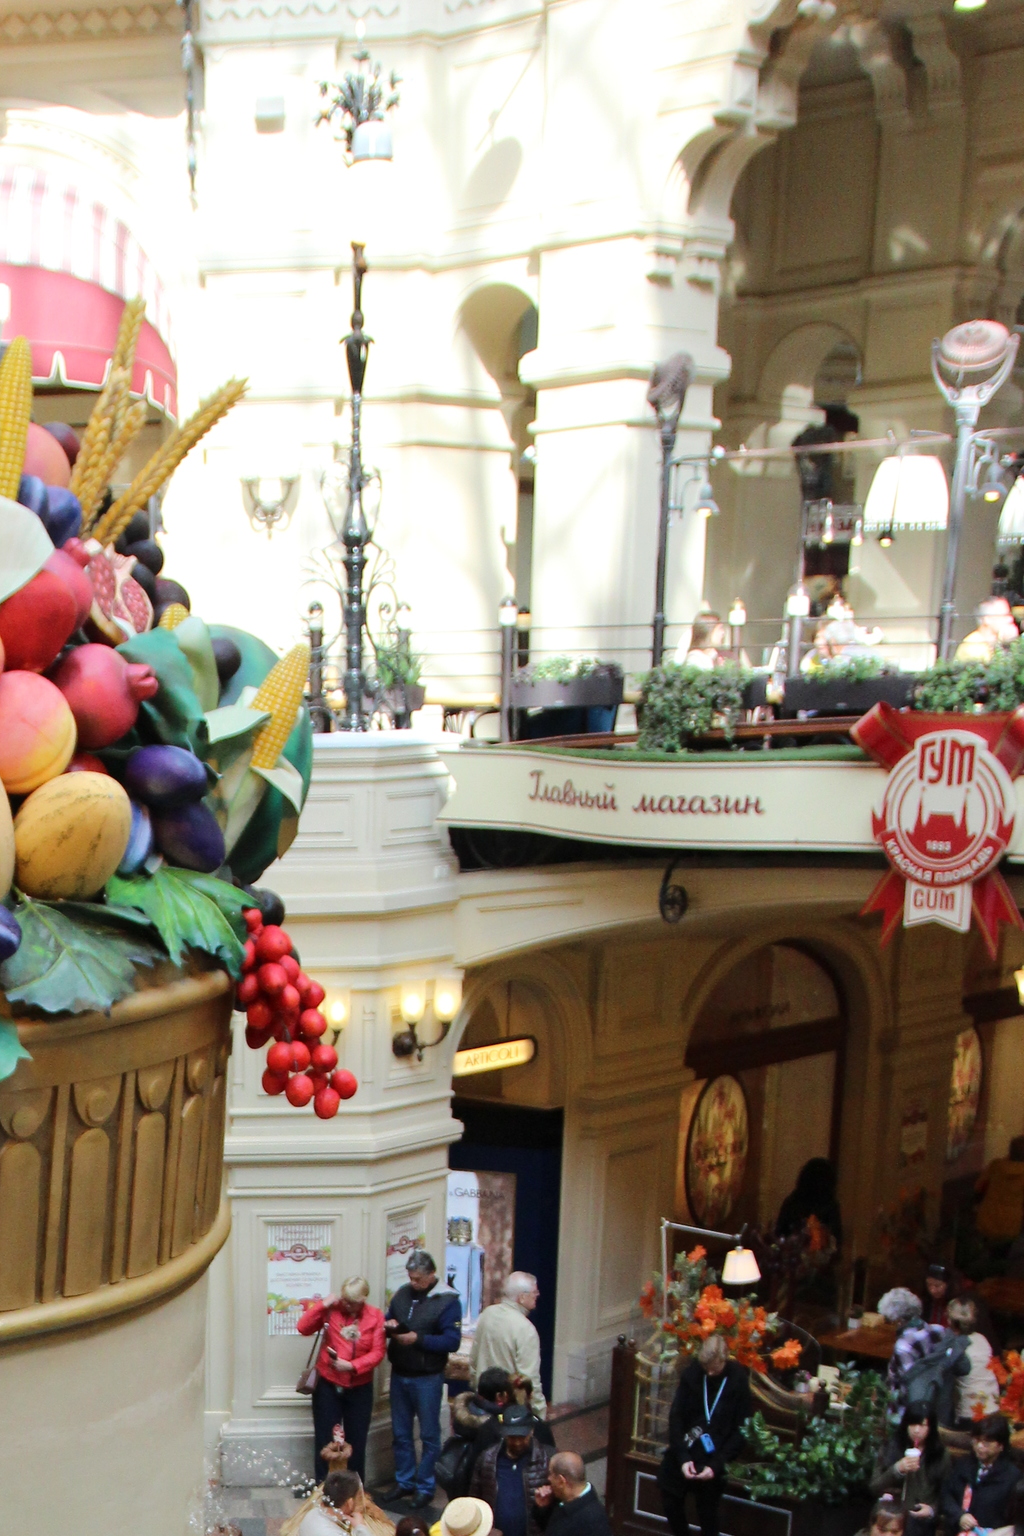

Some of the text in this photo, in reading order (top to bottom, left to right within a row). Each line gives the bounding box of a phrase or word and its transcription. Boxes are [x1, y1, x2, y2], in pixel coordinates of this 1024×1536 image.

[918, 736, 976, 786] ГУМ
[529, 768, 764, 815] Главный магазин
[885, 838, 994, 883] КРАСНАЯ ПЛОЩАДЬ
[913, 888, 955, 911] GUM
[463, 1045, 519, 1068] ARTICOLI
[454, 1187, 506, 1200] GABBANA
